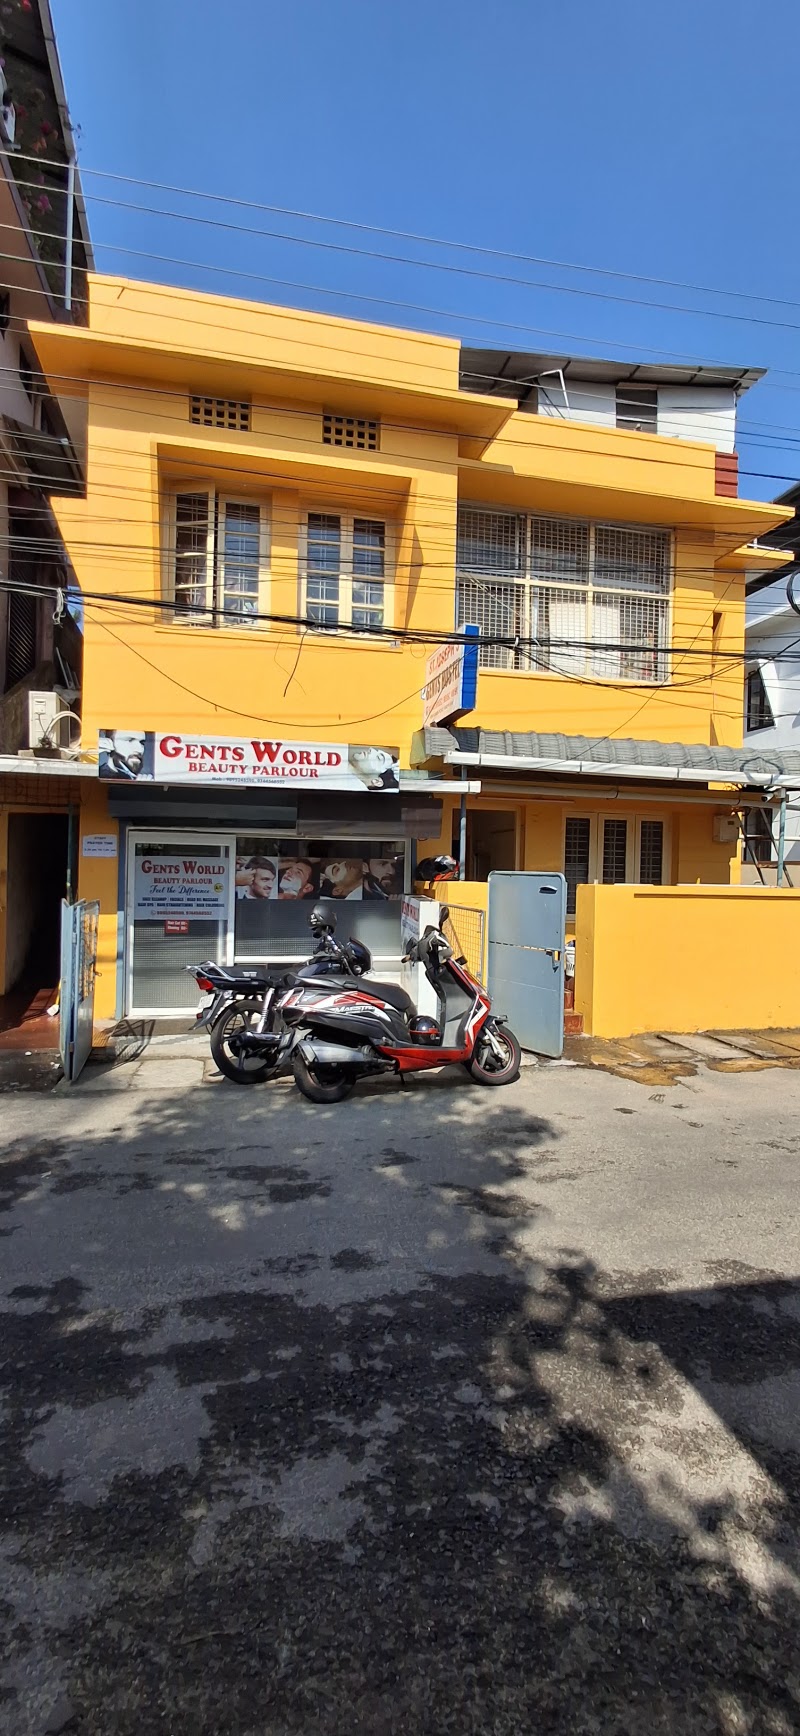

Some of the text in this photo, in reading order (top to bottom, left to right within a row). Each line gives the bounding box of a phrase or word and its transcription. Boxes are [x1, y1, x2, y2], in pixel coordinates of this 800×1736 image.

[159, 736, 342, 767] GENTS WORLD
[188, 762, 319, 779] BEAUTY PARLOUR
[141, 860, 225, 876] GENTS WORLD
[149, 885, 210, 896] Feel the Difference
